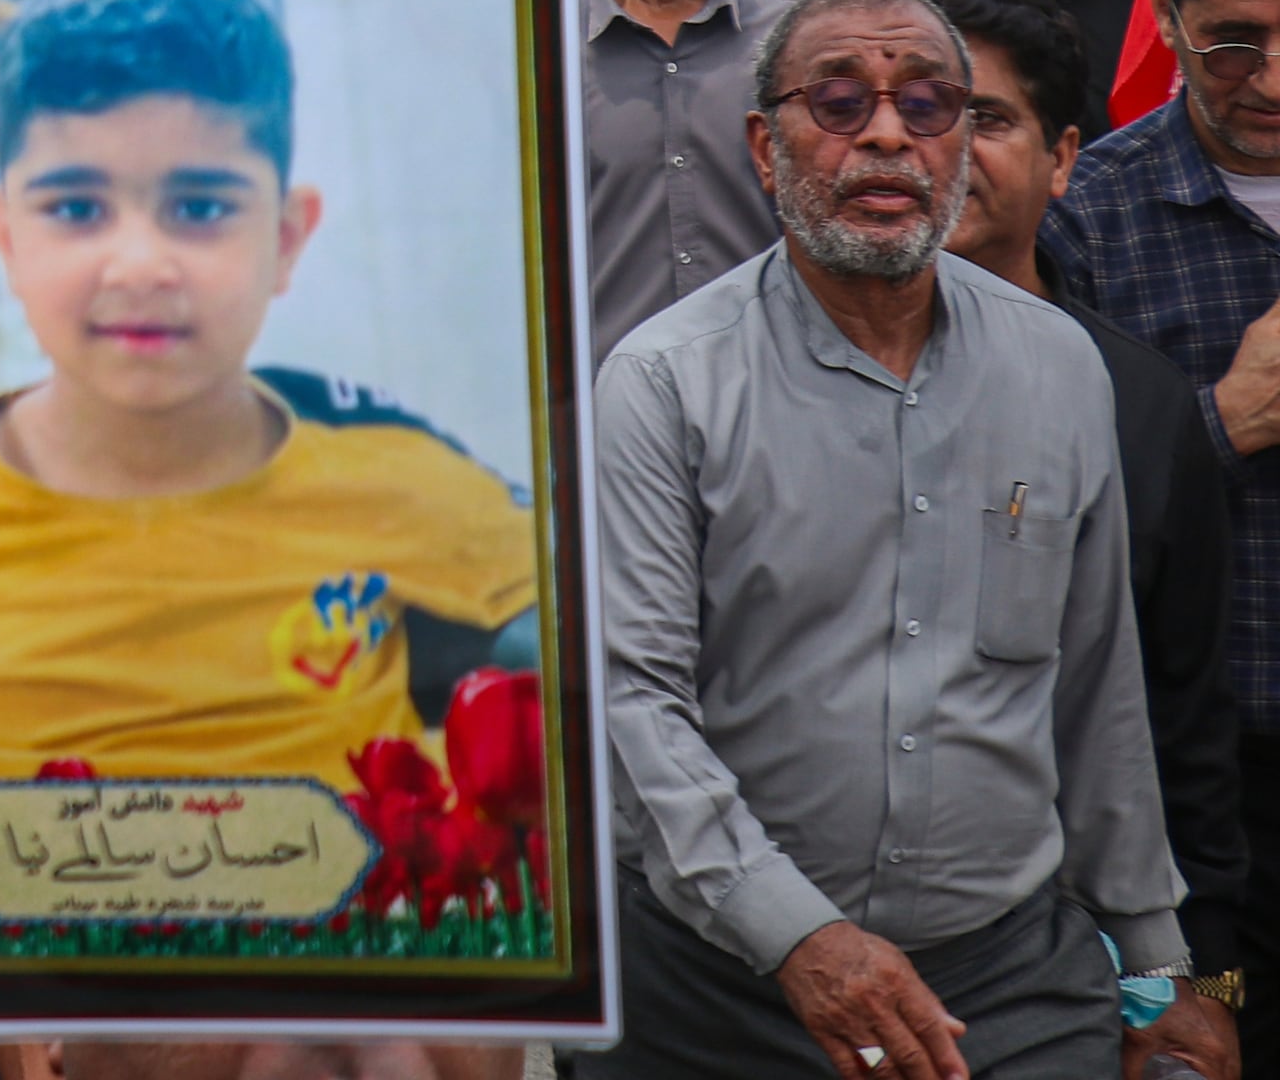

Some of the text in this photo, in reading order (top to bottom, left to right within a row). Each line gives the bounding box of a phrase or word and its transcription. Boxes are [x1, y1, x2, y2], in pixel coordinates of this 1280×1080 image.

[109, 791, 174, 819] دانش
[182, 791, 244, 817] شهید
[165, 820, 320, 879] احسان
